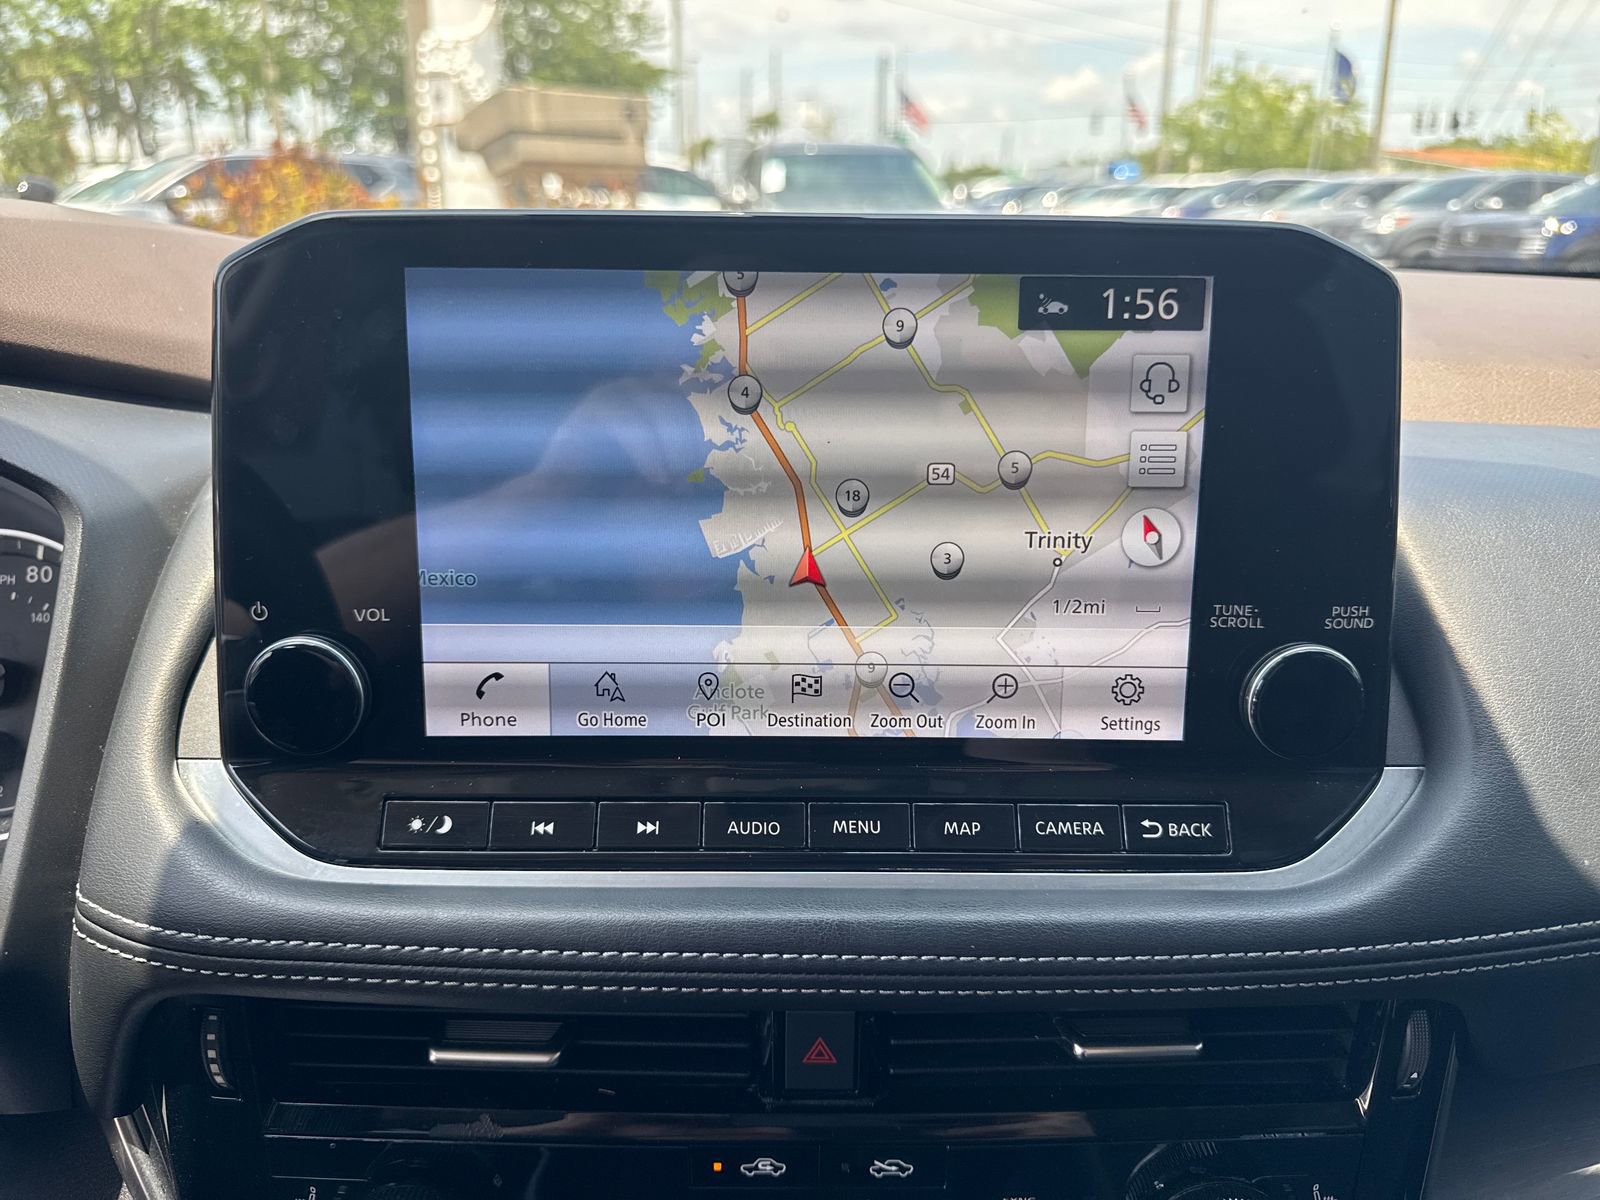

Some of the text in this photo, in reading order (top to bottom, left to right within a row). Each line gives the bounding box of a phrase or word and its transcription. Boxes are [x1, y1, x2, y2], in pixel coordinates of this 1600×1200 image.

[1102, 288, 1179, 320] 1:56
[895, 319, 905, 332] 9
[740, 386, 750, 399] 4
[931, 467, 950, 481] 54
[1011, 462, 1019, 474] 5
[844, 489, 861, 502] 18
[1025, 531, 1093, 553] Trinity
[943, 552, 951, 565] 3
[26, 565, 53, 583] 80
[1053, 599, 1106, 615] 1/2mi
[1332, 605, 1369, 617] PUSH
[31, 612, 51, 623] 140
[353, 608, 391, 622] VOL
[1209, 616, 1265, 629] SCROLL
[1324, 618, 1374, 630] SOUND
[867, 662, 875, 673] 9
[731, 704, 769, 720] Park
[460, 712, 517, 727] Phone
[578, 712, 648, 727] Go Home
[696, 712, 726, 727] POI
[767, 713, 852, 728] Destination
[870, 713, 944, 729] Zoom Out
[975, 714, 1036, 729] Zoom In
[1101, 716, 1161, 735] Settings
[727, 821, 781, 835] AUDIO
[832, 820, 882, 834] MENU
[943, 821, 981, 835] MAP
[1035, 821, 1105, 836] CAMERA
[1168, 822, 1213, 837] BACK
